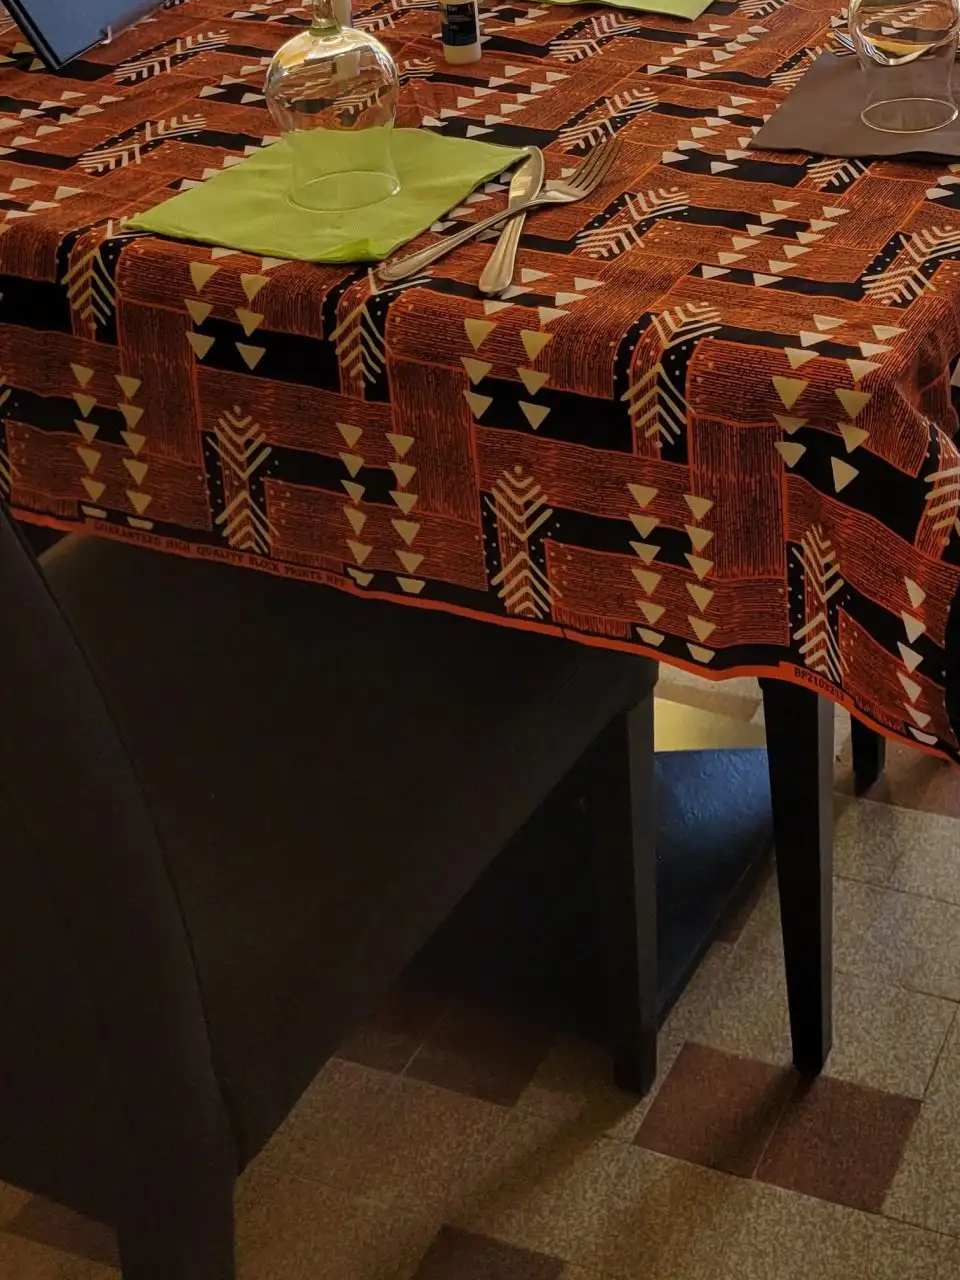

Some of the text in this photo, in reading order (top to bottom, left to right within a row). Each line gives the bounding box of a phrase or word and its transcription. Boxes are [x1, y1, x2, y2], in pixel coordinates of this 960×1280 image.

[93, 521, 162, 546] GUARANTEED
[165, 536, 190, 553] HIGH
[196, 545, 242, 562] QUALITY
[249, 554, 280, 573] BLOCK
[284, 564, 322, 580] PRINTS
